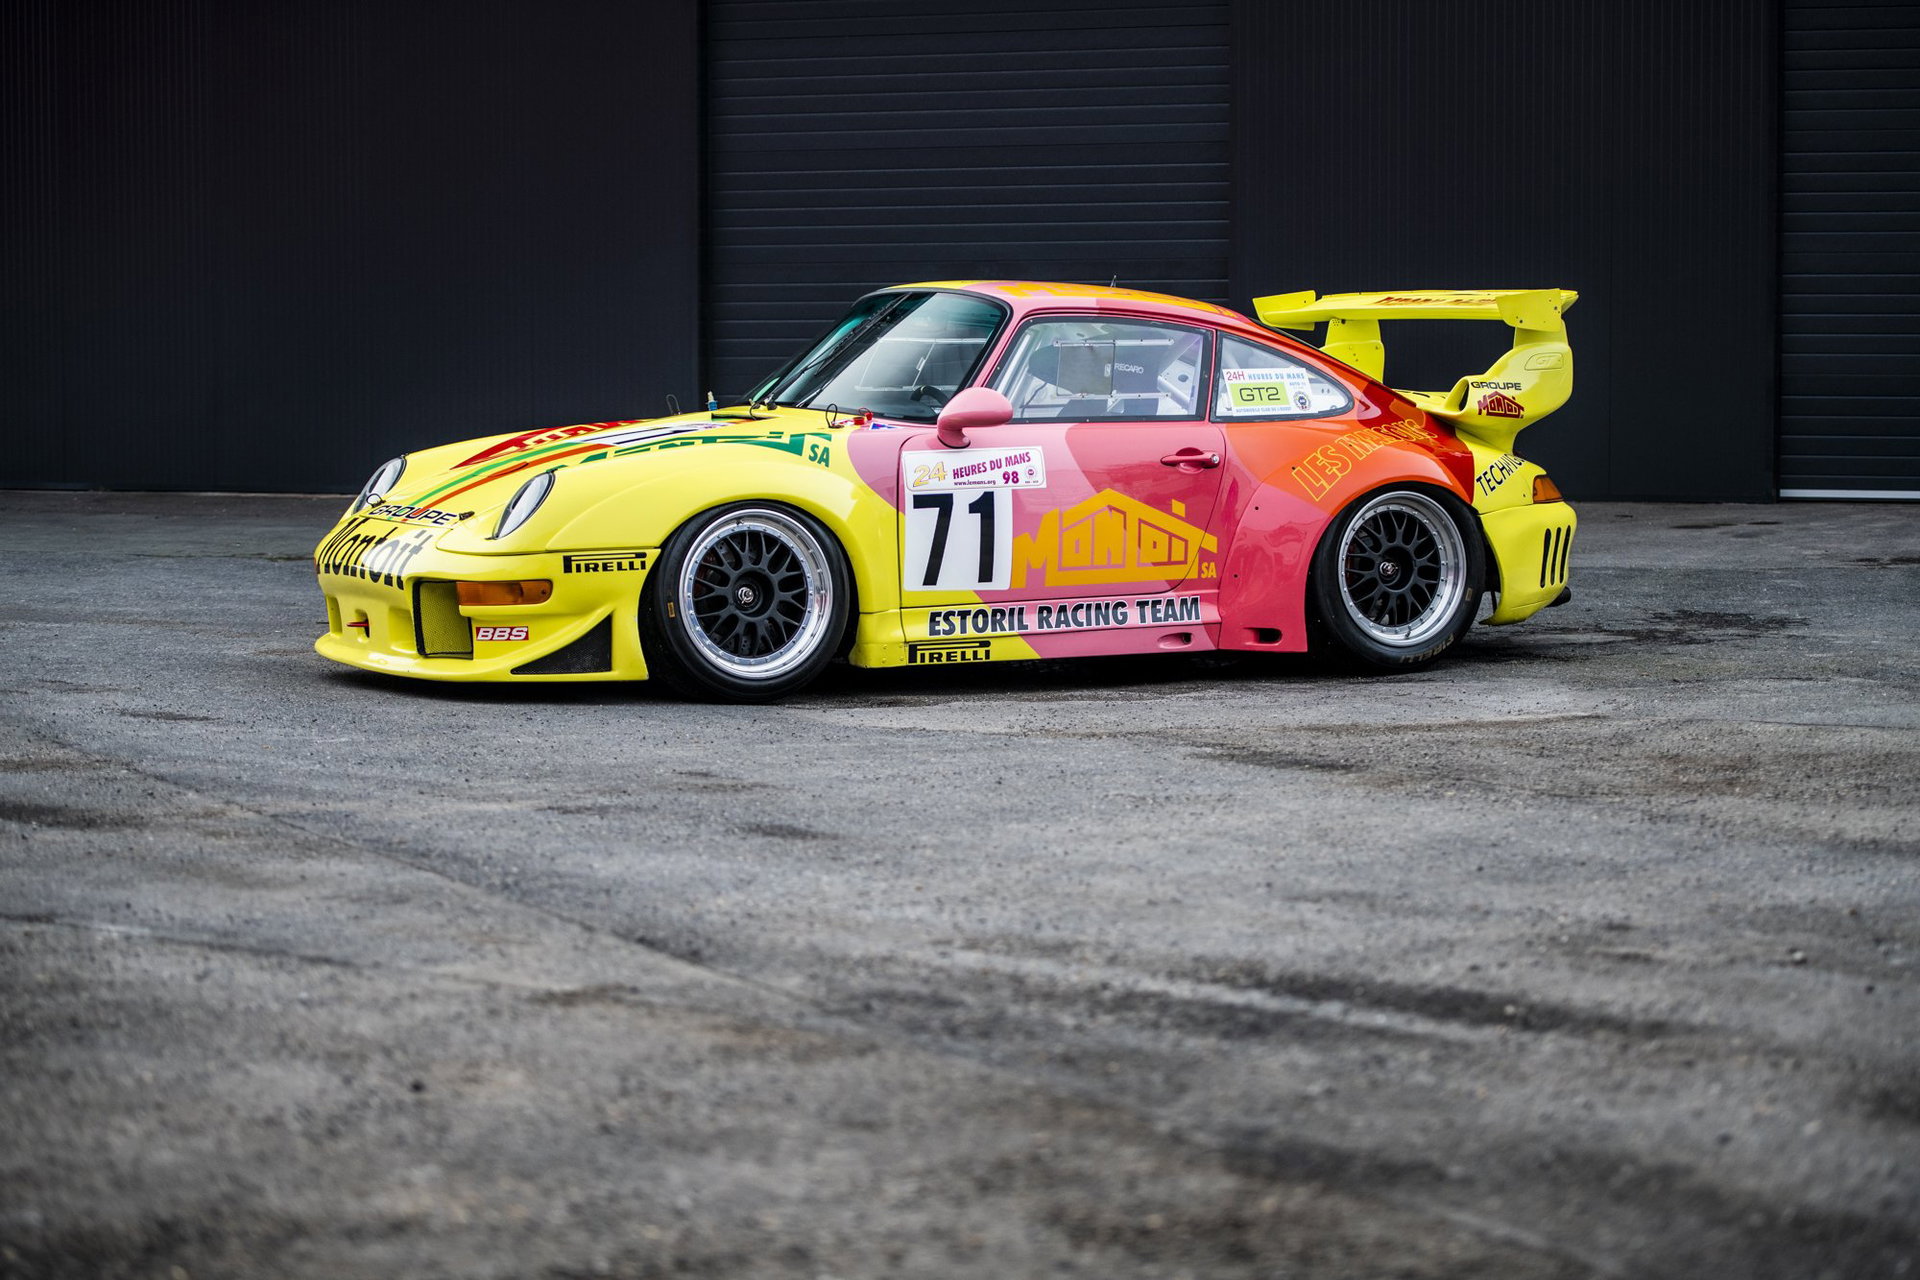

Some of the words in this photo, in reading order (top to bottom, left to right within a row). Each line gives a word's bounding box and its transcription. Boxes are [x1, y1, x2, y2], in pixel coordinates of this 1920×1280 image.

[1114, 362, 1144, 374] RECARO
[1226, 371, 1245, 381] 24H
[1239, 387, 1280, 402] GT2
[1471, 381, 1522, 391] GROUPE
[808, 443, 830, 468] SA
[912, 461, 948, 487] 24
[952, 462, 988, 480] HEURES
[989, 458, 1003, 471] DU
[1004, 451, 1031, 467] MANS
[1002, 470, 1020, 485] 98
[1291, 444, 1353, 502] LES
[953, 478, 997, 487] www.lemans.org
[368, 504, 458, 526] GROUPE
[912, 490, 996, 586] 71
[562, 551, 647, 574] PIRELLI
[1200, 561, 1217, 579] SA
[928, 605, 1029, 637] ESTORIL
[1037, 600, 1129, 631] RACING
[1136, 596, 1201, 625] TEAM
[476, 627, 528, 641] BBS
[907, 639, 992, 664] PIRELLI
